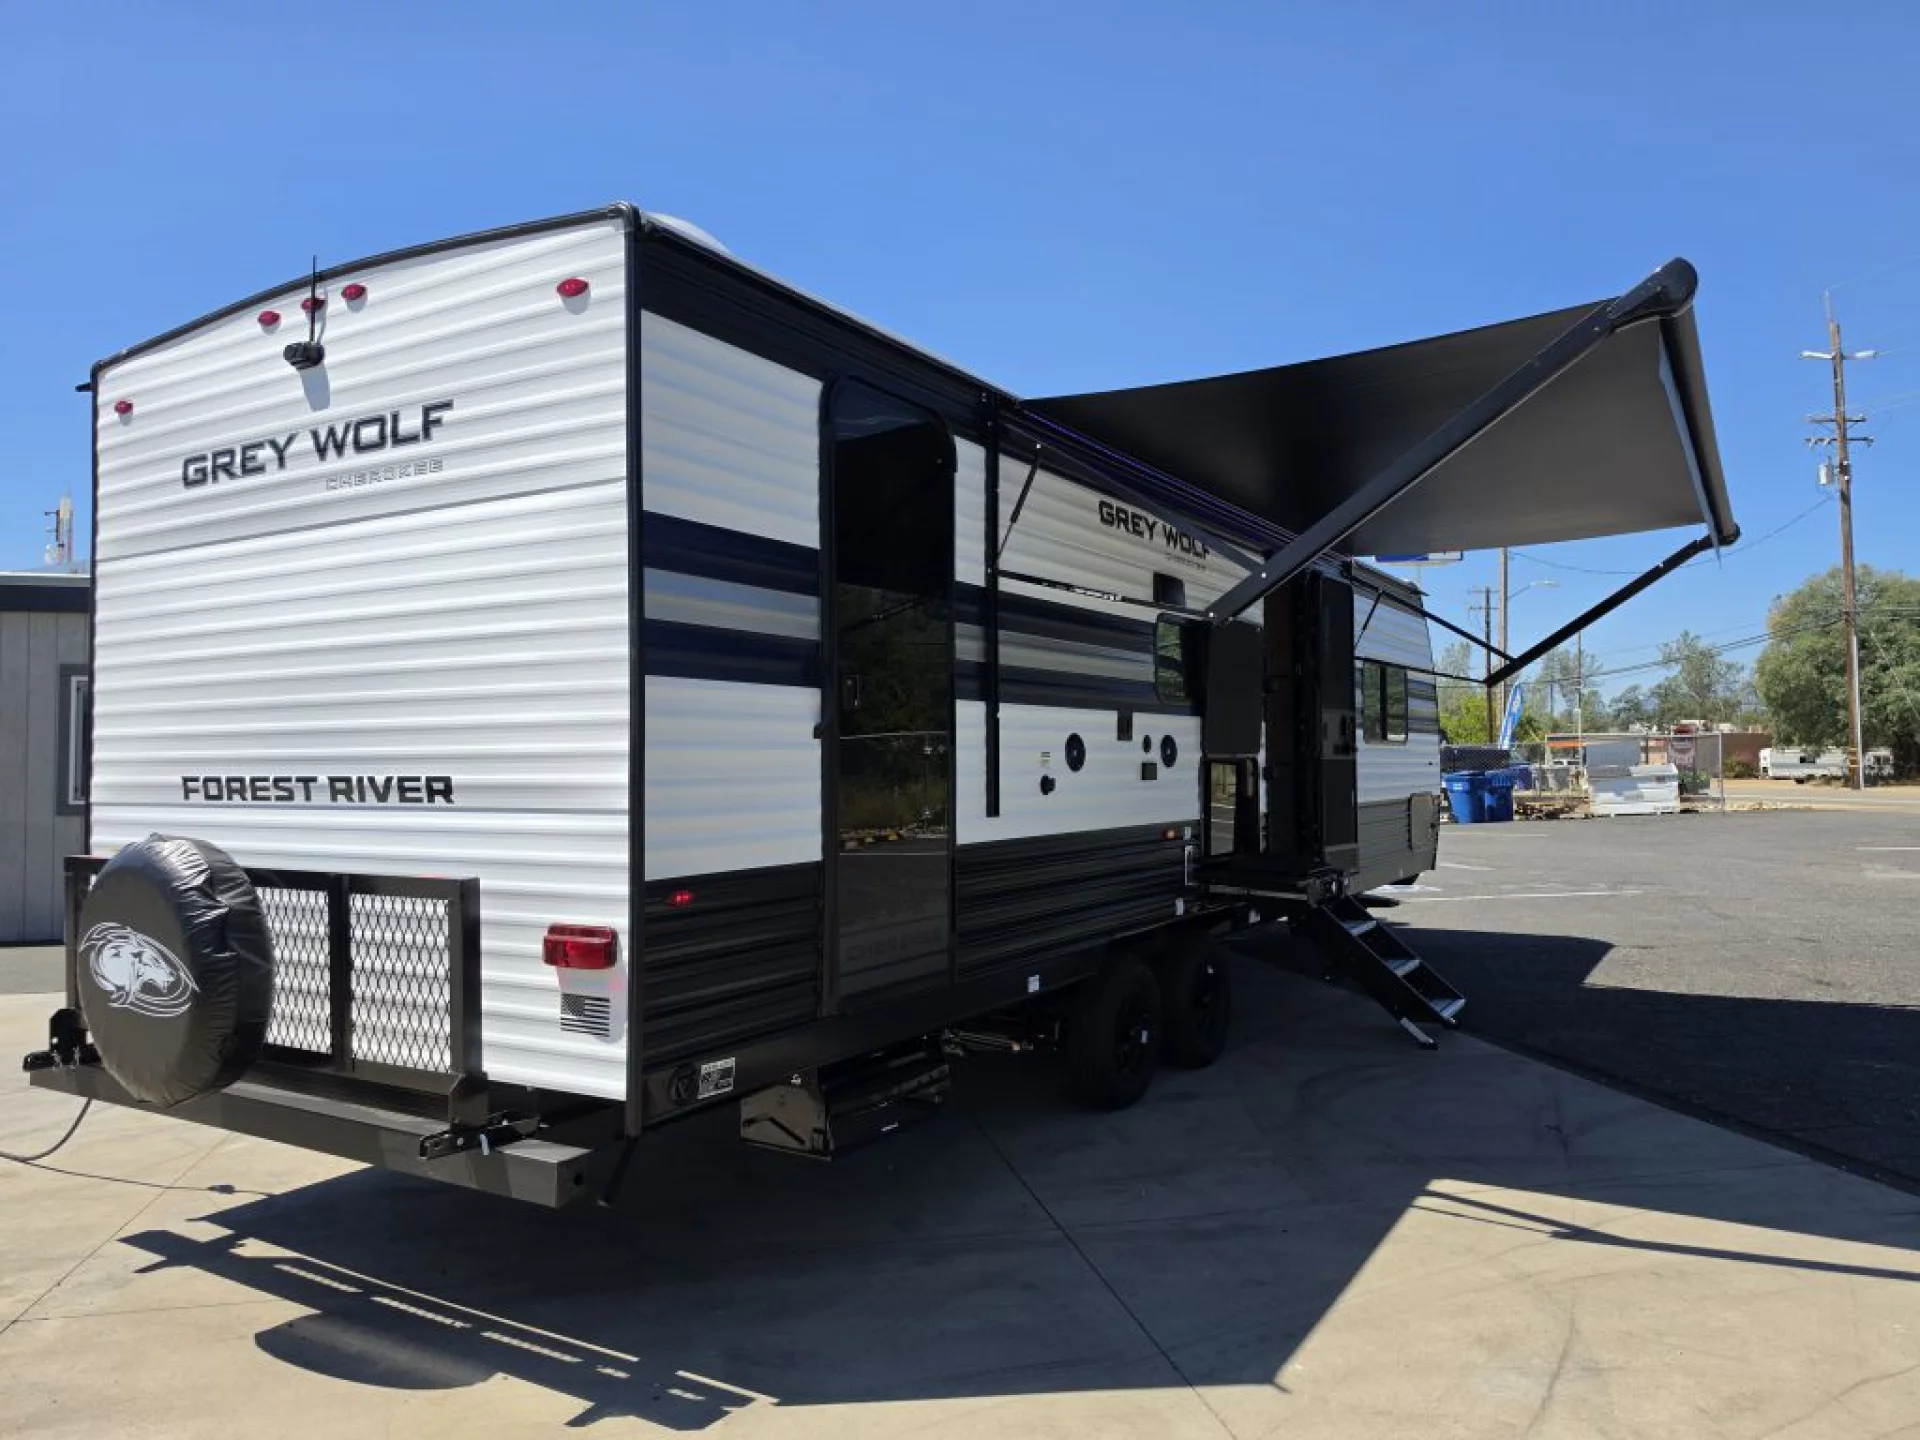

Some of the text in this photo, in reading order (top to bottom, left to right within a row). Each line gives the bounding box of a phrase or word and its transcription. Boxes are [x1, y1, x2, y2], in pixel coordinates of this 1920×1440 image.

[182, 399, 454, 489] GREY WOLF
[1098, 499, 1157, 541] GREY
[181, 775, 455, 804] FOREST RIVER
